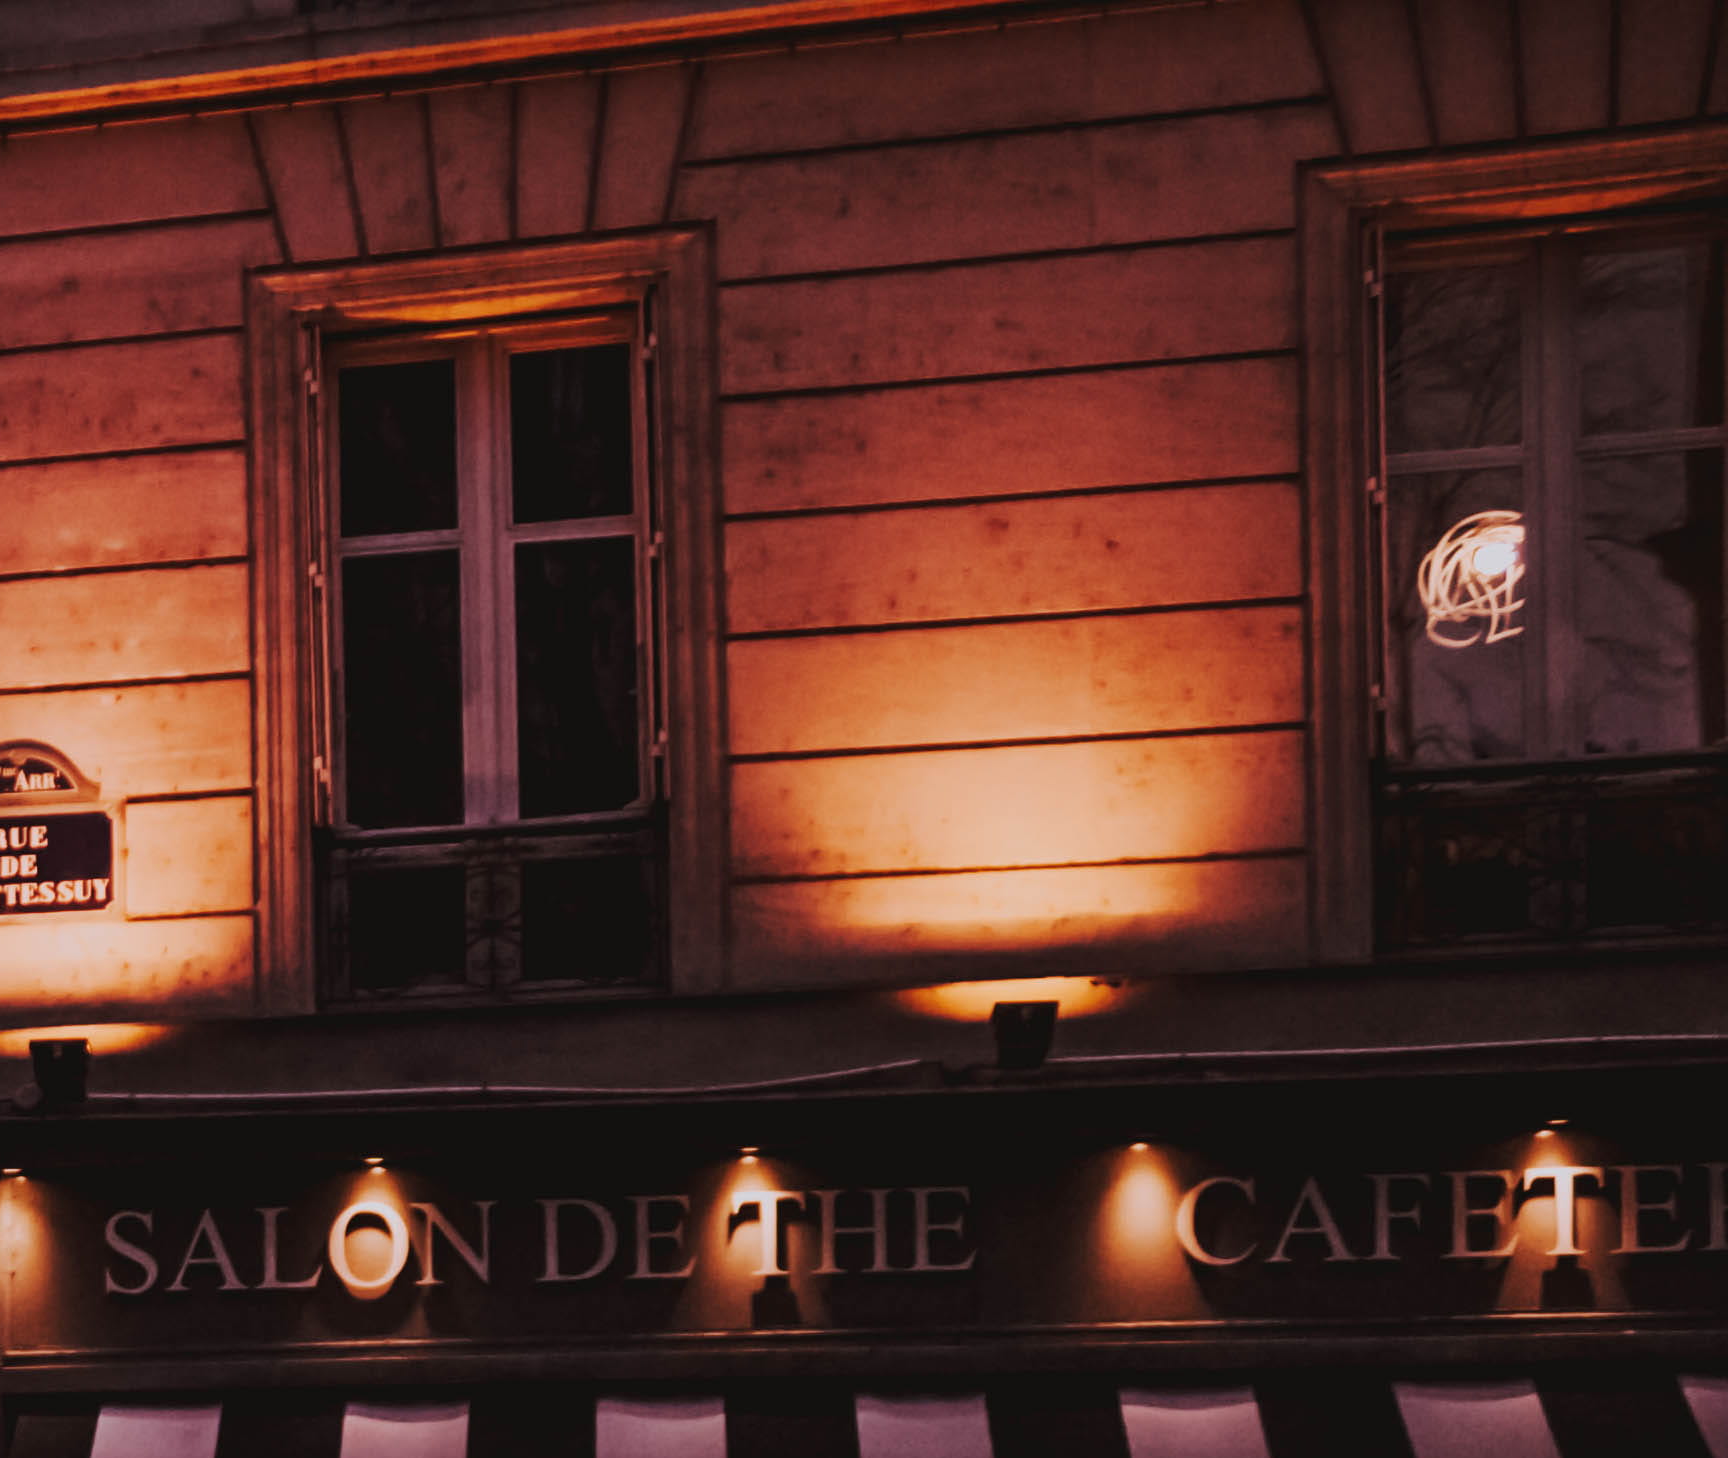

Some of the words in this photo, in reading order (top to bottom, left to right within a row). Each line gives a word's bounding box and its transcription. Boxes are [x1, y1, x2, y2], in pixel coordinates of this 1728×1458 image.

[0, 854, 38, 878] DE
[104, 1200, 497, 1296] SALON
[534, 1194, 697, 1284] DE
[730, 1186, 977, 1279] THE
